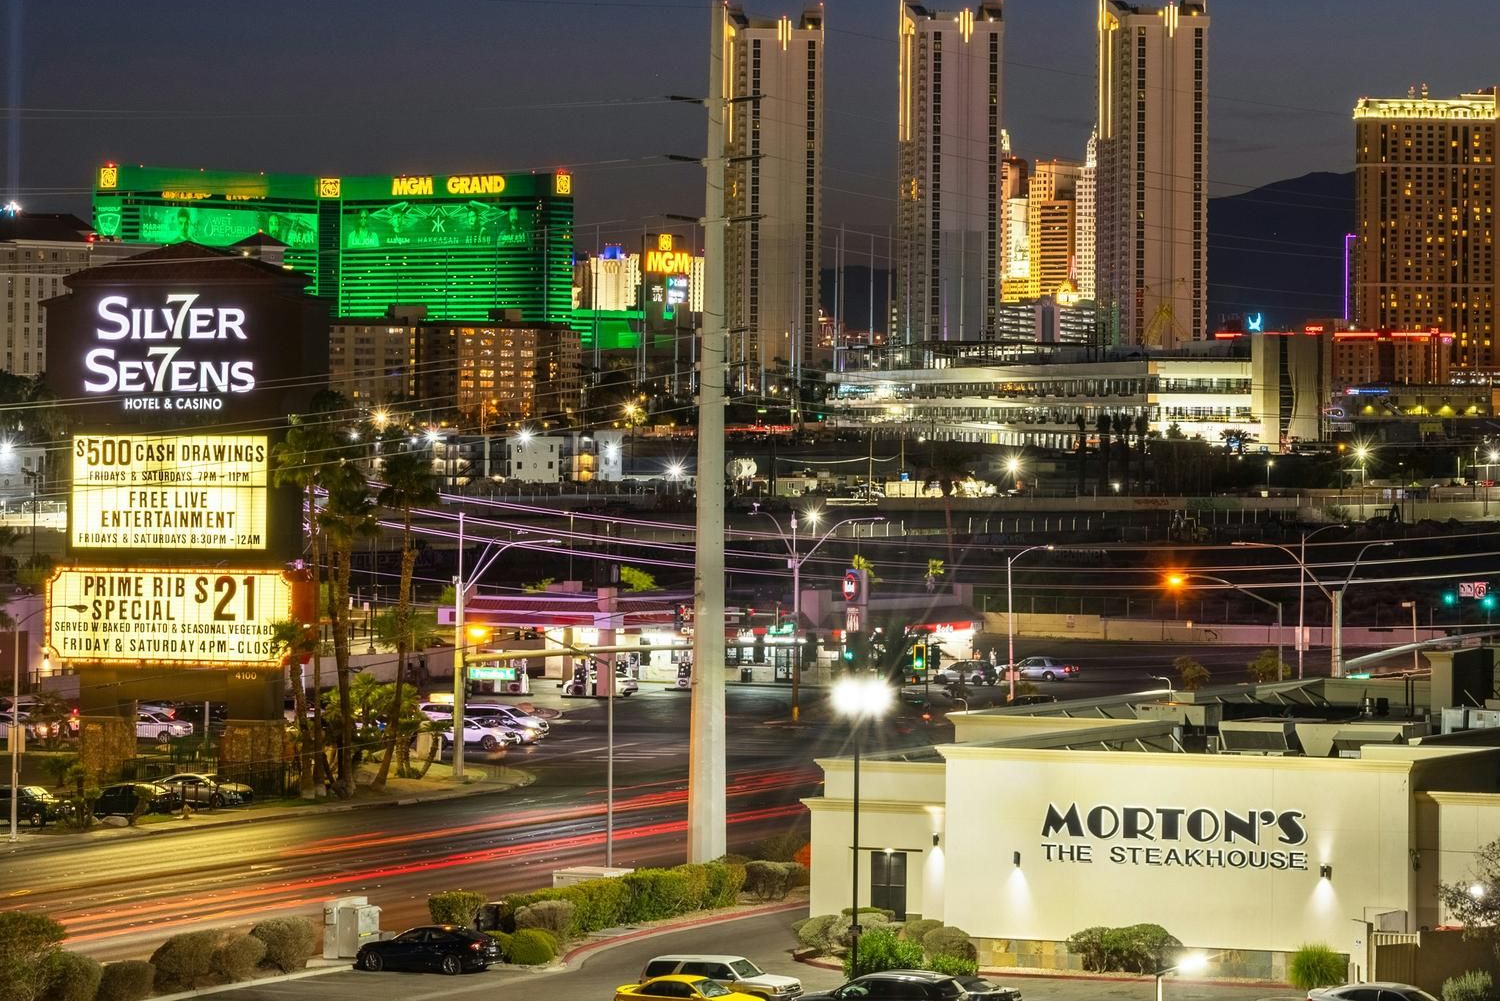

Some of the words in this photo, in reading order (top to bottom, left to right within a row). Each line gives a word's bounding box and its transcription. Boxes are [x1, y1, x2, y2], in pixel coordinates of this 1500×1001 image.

[392, 176, 433, 195] MGM
[447, 175, 505, 194] GRAND
[213, 217, 232, 225] WET
[647, 251, 690, 275] MGM
[125, 398, 161, 410] HOTEL
[164, 398, 172, 410] &
[176, 398, 222, 410] CASINO
[76, 439, 132, 466] $500
[136, 444, 175, 462] CASH
[182, 444, 265, 463] DRAWINGS
[89, 471, 126, 481] FRIDAYS
[131, 471, 137, 481] &
[142, 471, 192, 482] SATURDAYS
[198, 471, 217, 482] 7PM
[228, 472, 250, 482] 11PM
[129, 491, 168, 508] FREE
[174, 491, 208, 508] LIVE
[101, 511, 236, 528] ENTERTAINMENT
[79, 533, 117, 544] FRIDAYS
[122, 533, 129, 544] &
[133, 533, 187, 544] SATURDAYS
[190, 534, 227, 545] 8:30PM
[237, 535, 261, 545] 12AM
[84, 576, 143, 597] PRIME
[153, 576, 185, 597] RIB
[195, 575, 255, 621] $21
[92, 600, 175, 621] SPECIAL
[55, 621, 88, 632] SERVED
[134, 623, 168, 633] POTATO
[171, 623, 178, 633] &
[180, 623, 226, 634] SEASONAL
[229, 624, 277, 636] VEGETABL
[63, 638, 110, 651] FRIDAY
[115, 638, 123, 652] &
[130, 639, 194, 653] SATURDAY
[235, 672, 257, 680] 4100
[1041, 802, 1308, 845] MORTON'S
[1041, 843, 1093, 863] THE
[1109, 845, 1308, 871] STEAKHOUSE
